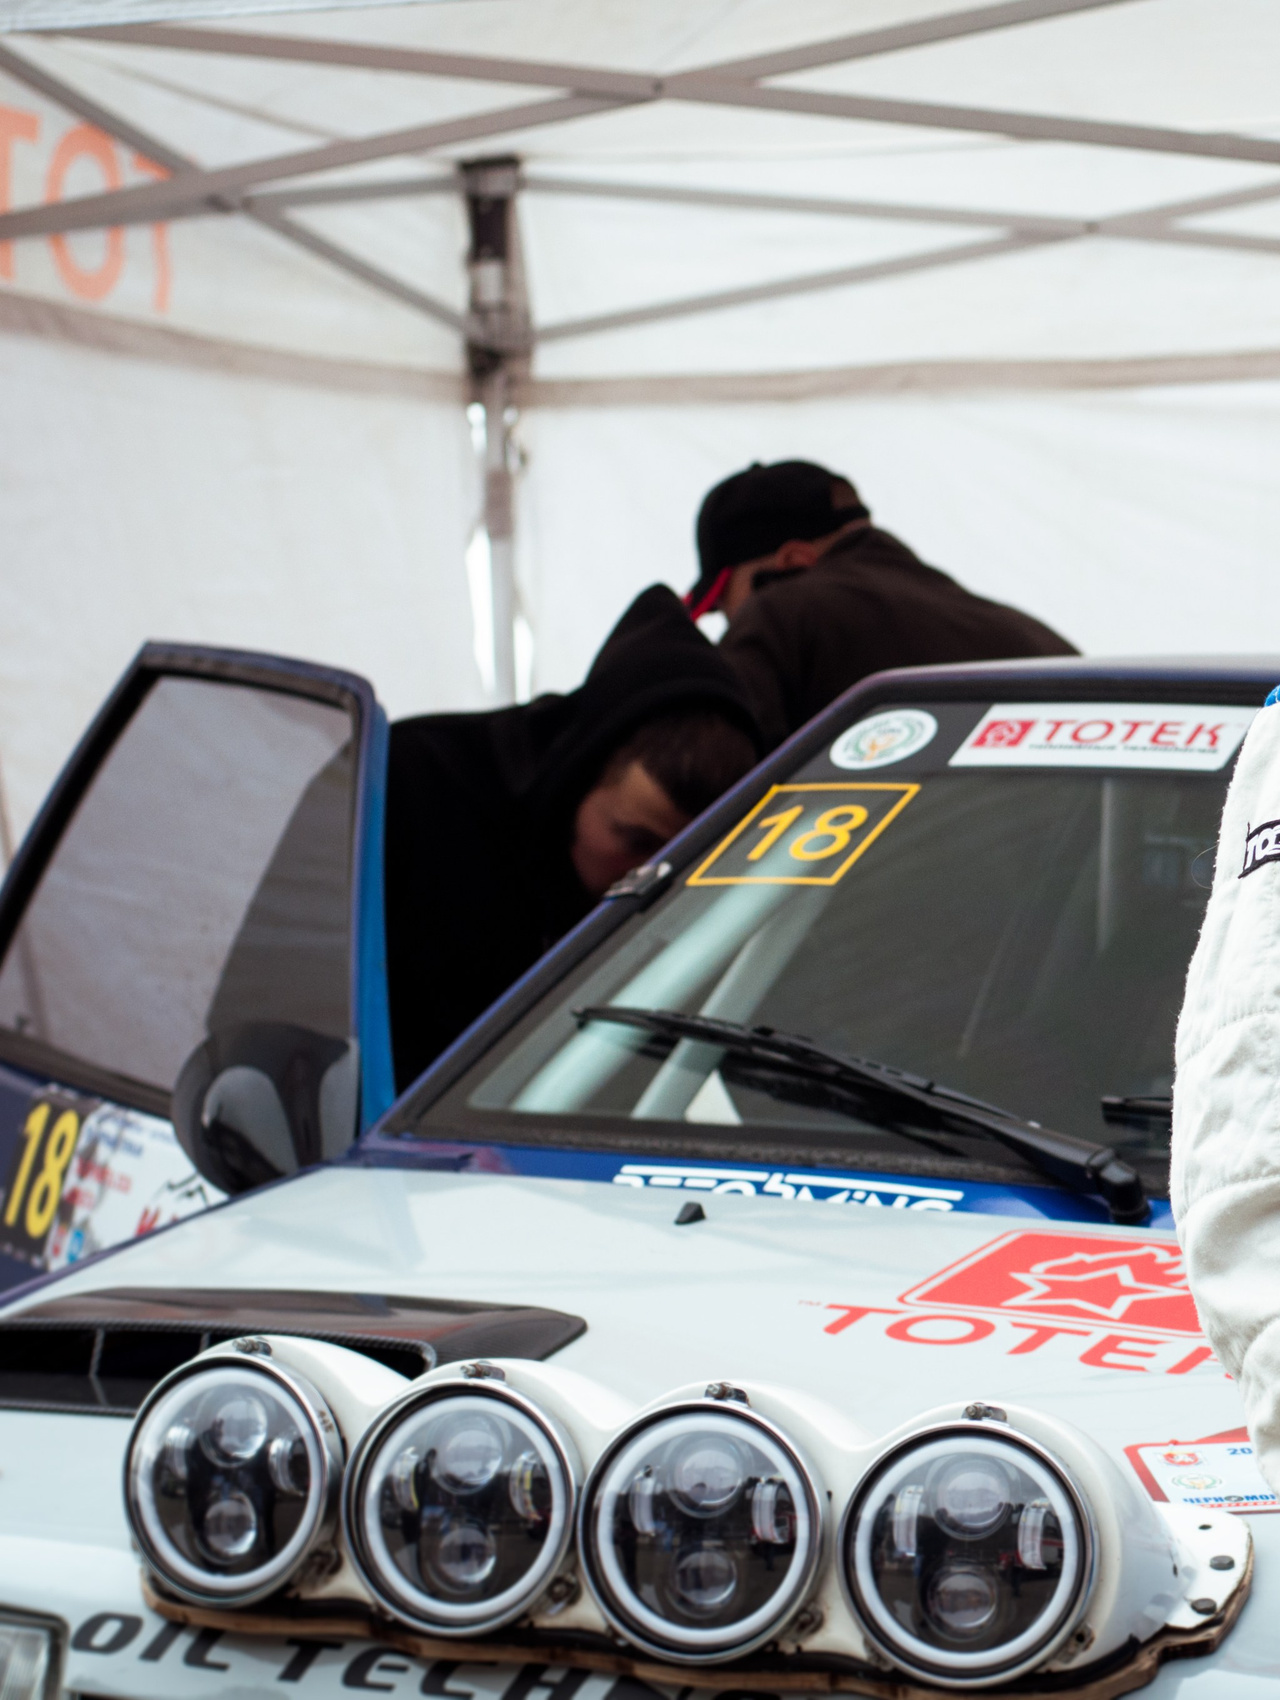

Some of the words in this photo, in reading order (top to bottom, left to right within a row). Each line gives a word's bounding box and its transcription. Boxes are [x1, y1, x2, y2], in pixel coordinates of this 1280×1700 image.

[1044, 719, 1225, 747] TOTEK
[747, 804, 869, 861] 18
[4, 1102, 79, 1239] 18
[71, 1612, 230, 1672] OIL
